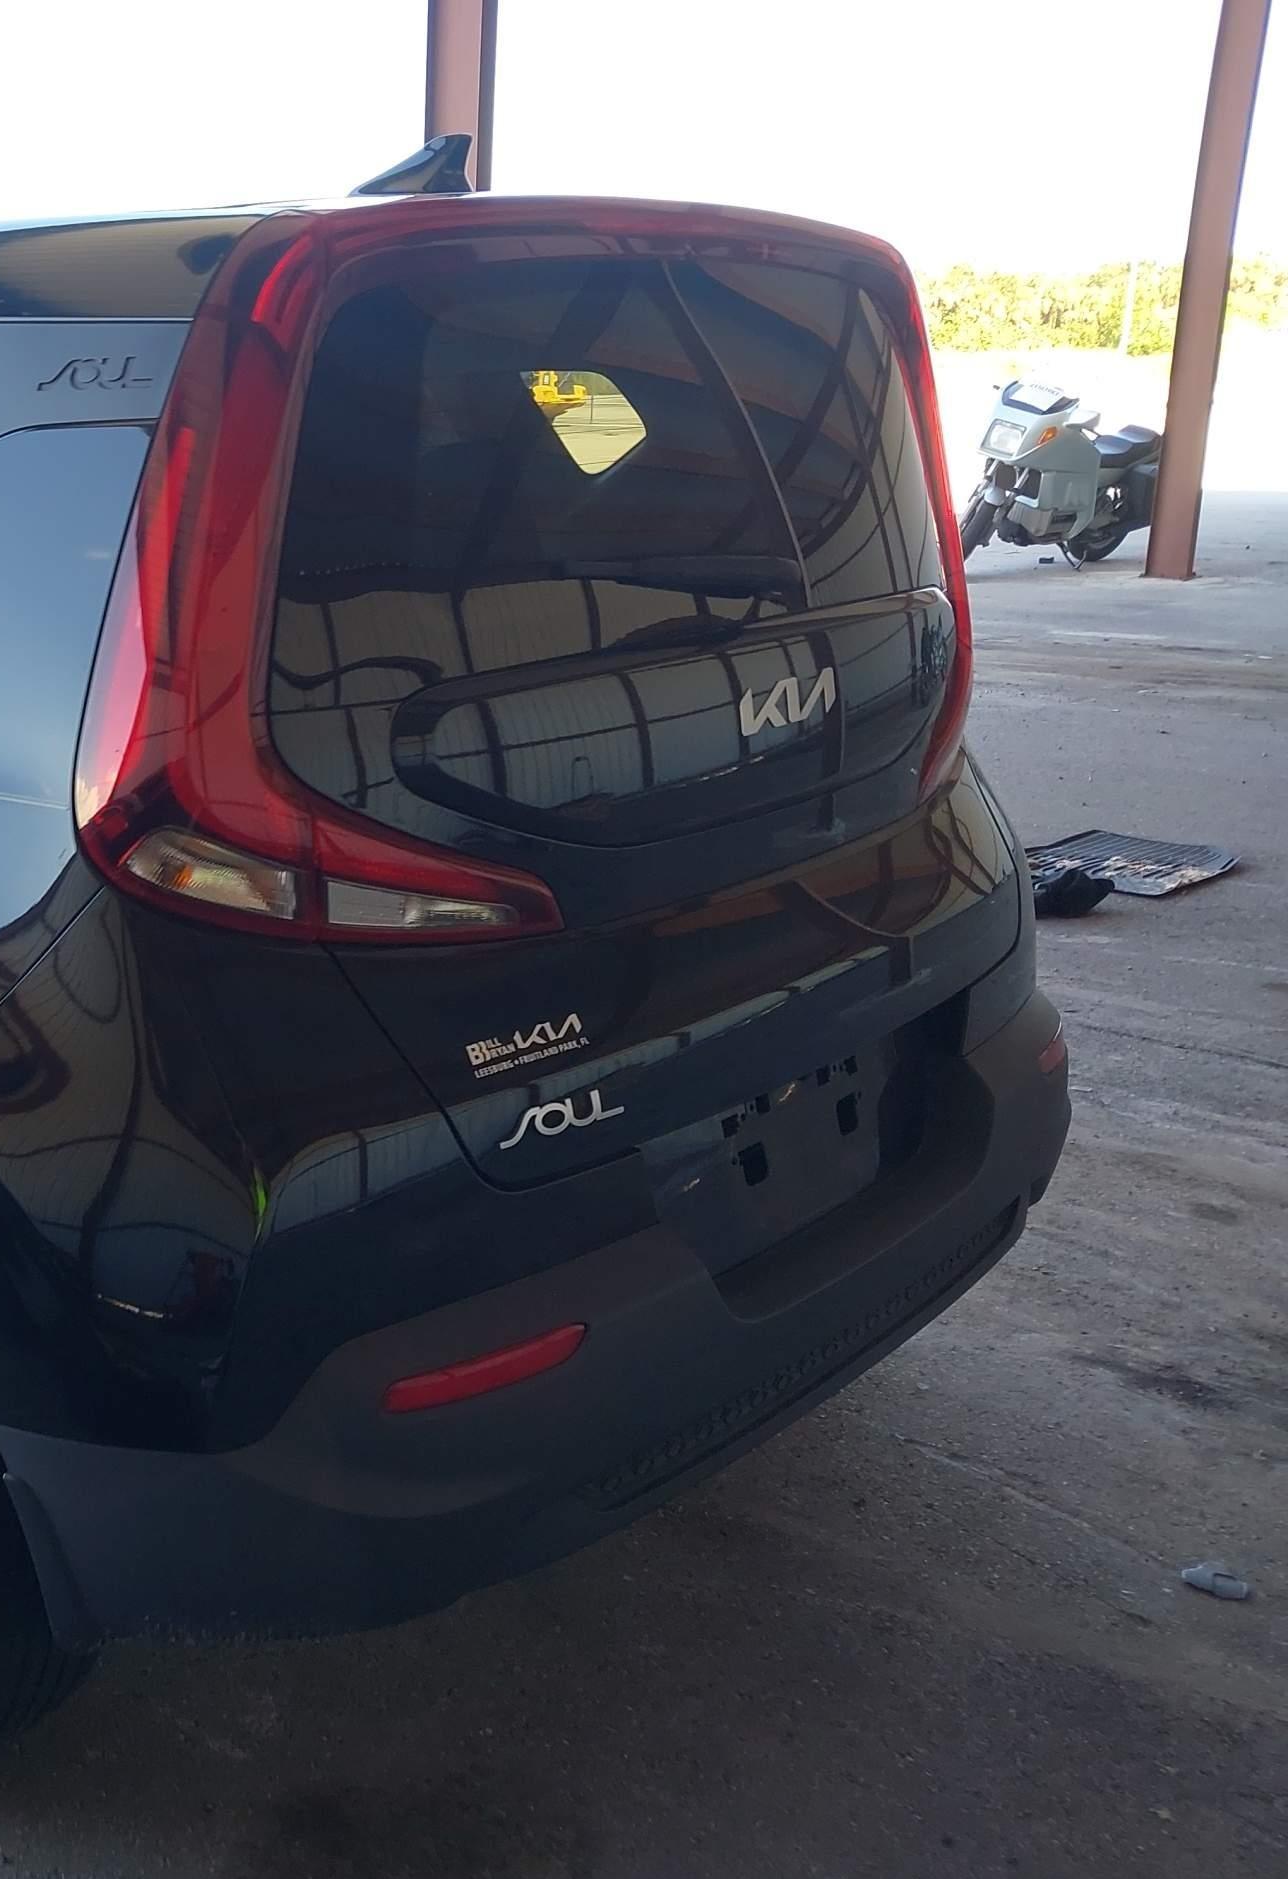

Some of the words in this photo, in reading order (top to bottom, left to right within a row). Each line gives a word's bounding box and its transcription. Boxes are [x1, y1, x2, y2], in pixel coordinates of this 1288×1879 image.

[36, 355, 153, 392] SOUL
[738, 666, 836, 737] KIA
[513, 1012, 583, 1050] KIA
[499, 1089, 625, 1150] SOUL
